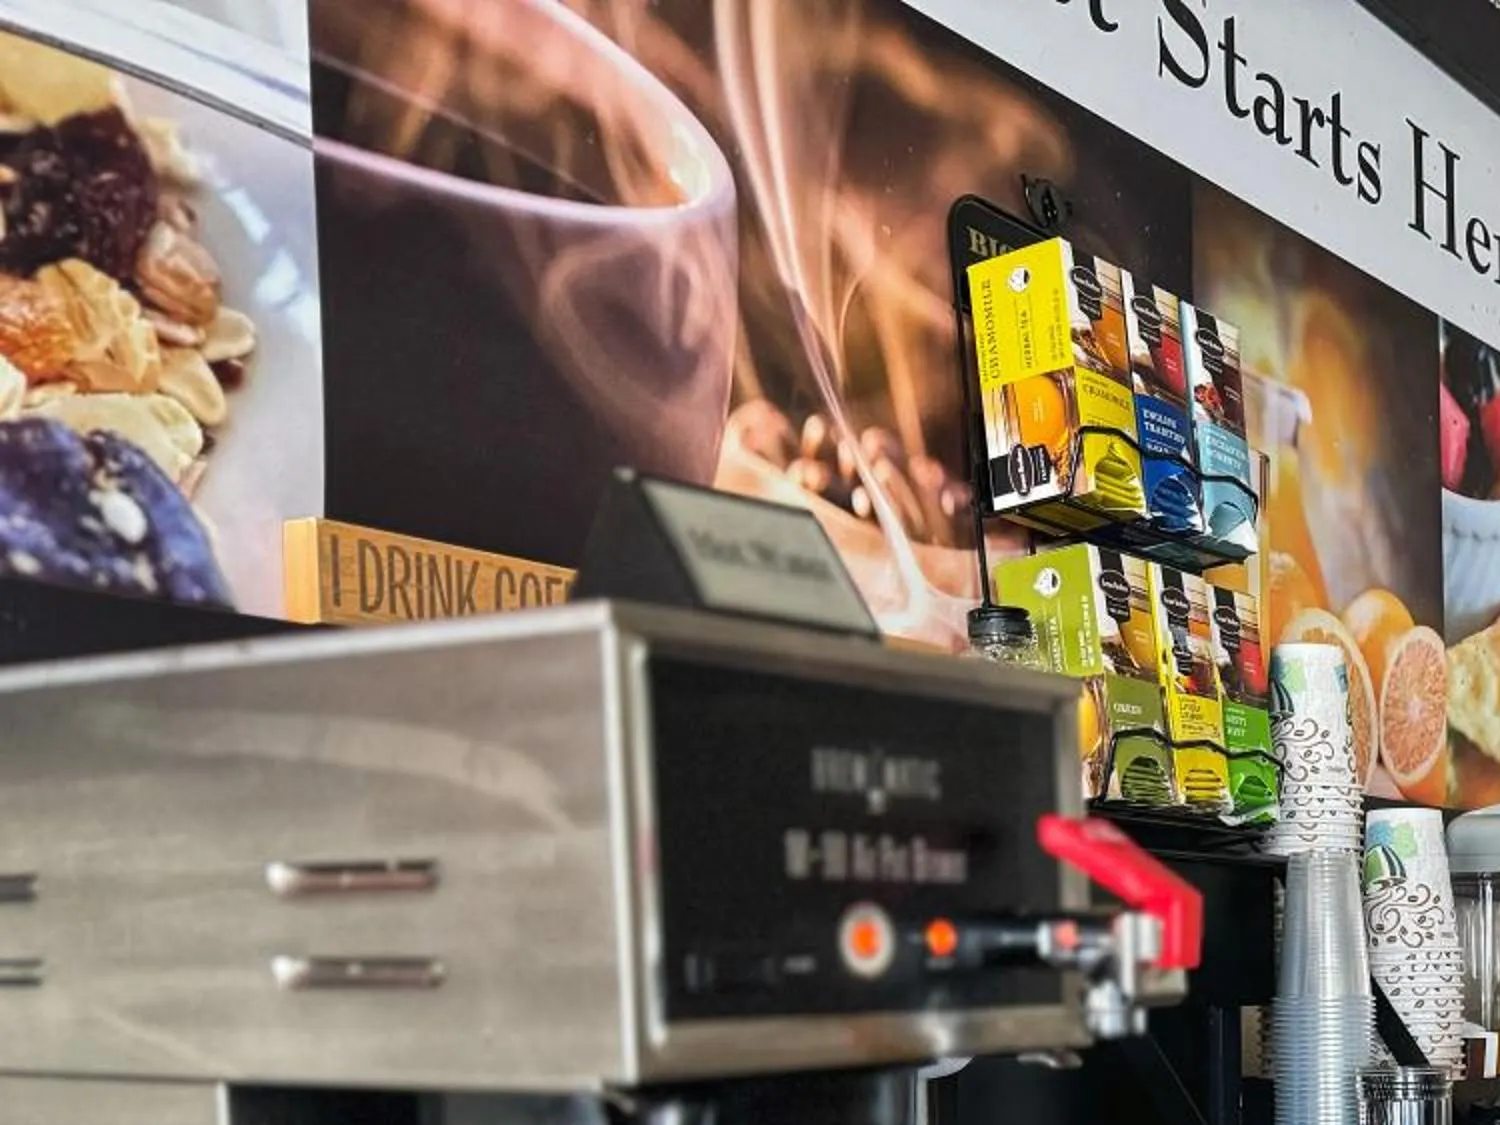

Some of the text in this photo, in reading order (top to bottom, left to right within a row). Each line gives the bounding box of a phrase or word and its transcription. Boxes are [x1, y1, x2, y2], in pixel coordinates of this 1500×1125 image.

[1157, 0, 1382, 205] Starts
[329, 534, 342, 608] I
[357, 538, 481, 621] DRINK
